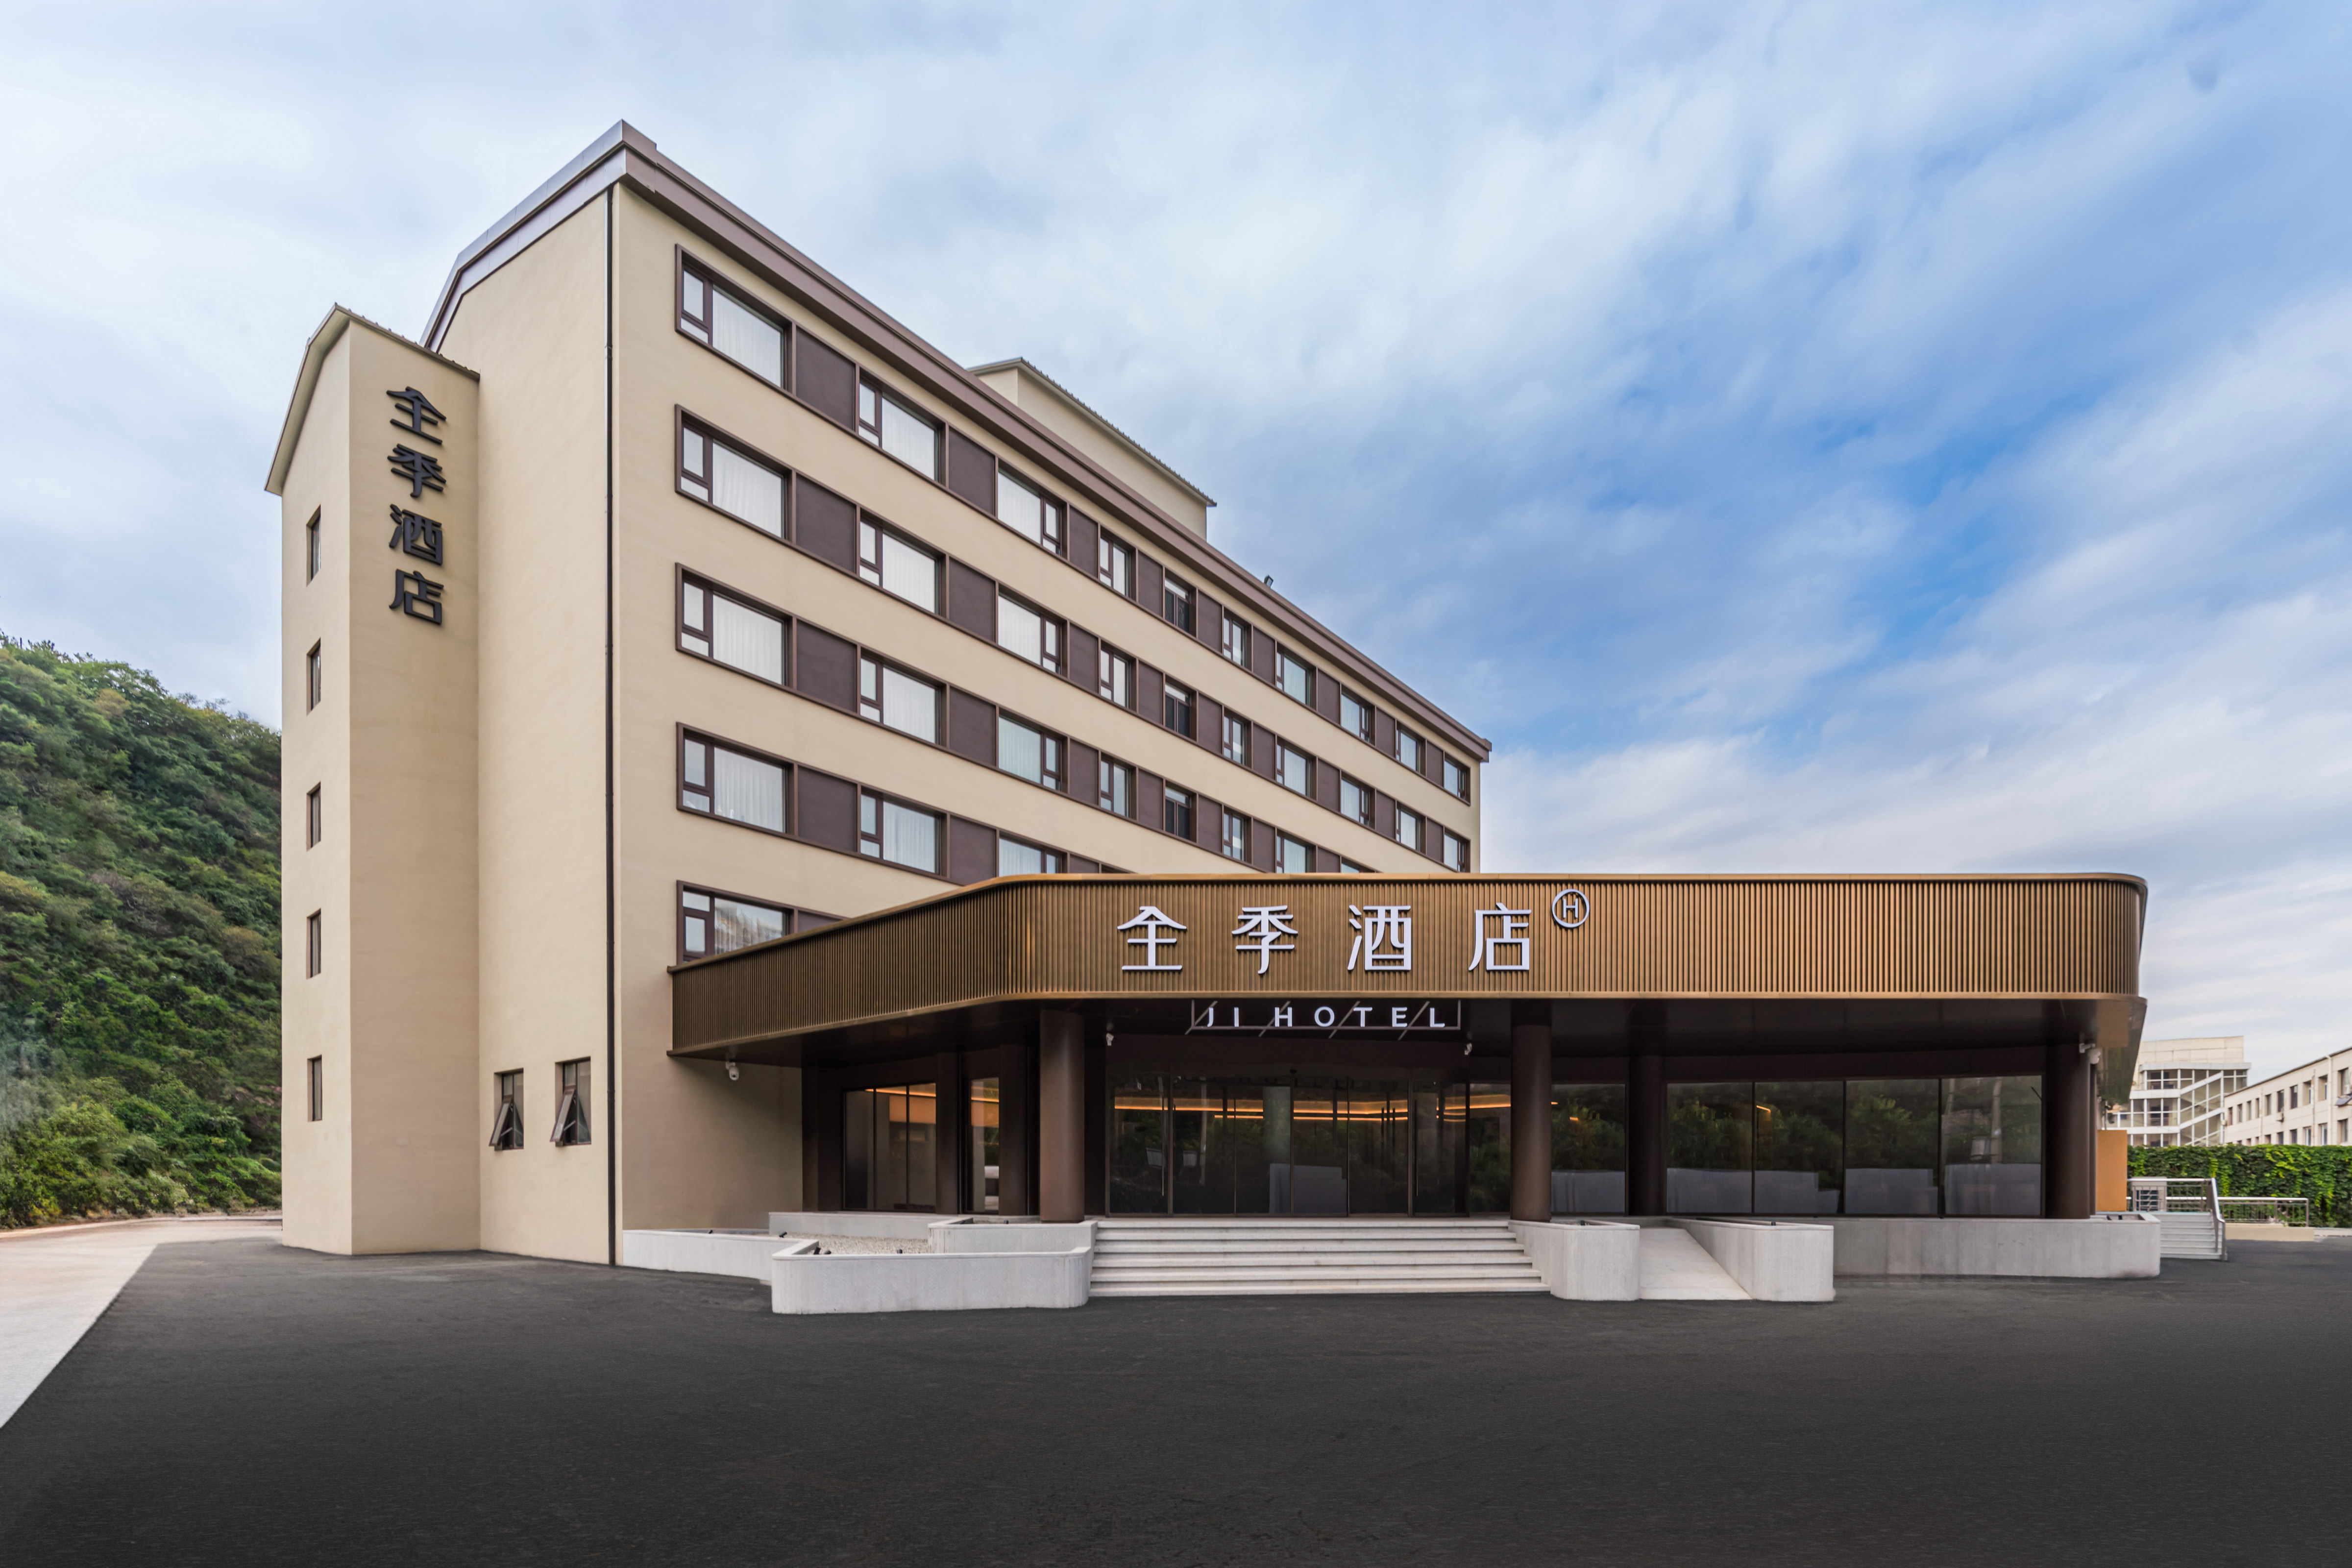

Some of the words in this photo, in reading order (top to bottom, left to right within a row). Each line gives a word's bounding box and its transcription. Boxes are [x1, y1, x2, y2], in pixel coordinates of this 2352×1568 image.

[386, 386, 447, 625] 全季酒店
[1117, 902, 1532, 974] 全季酒店
[1207, 1007, 1240, 1028] JI
[1274, 1006, 1446, 1028] HOTEL
